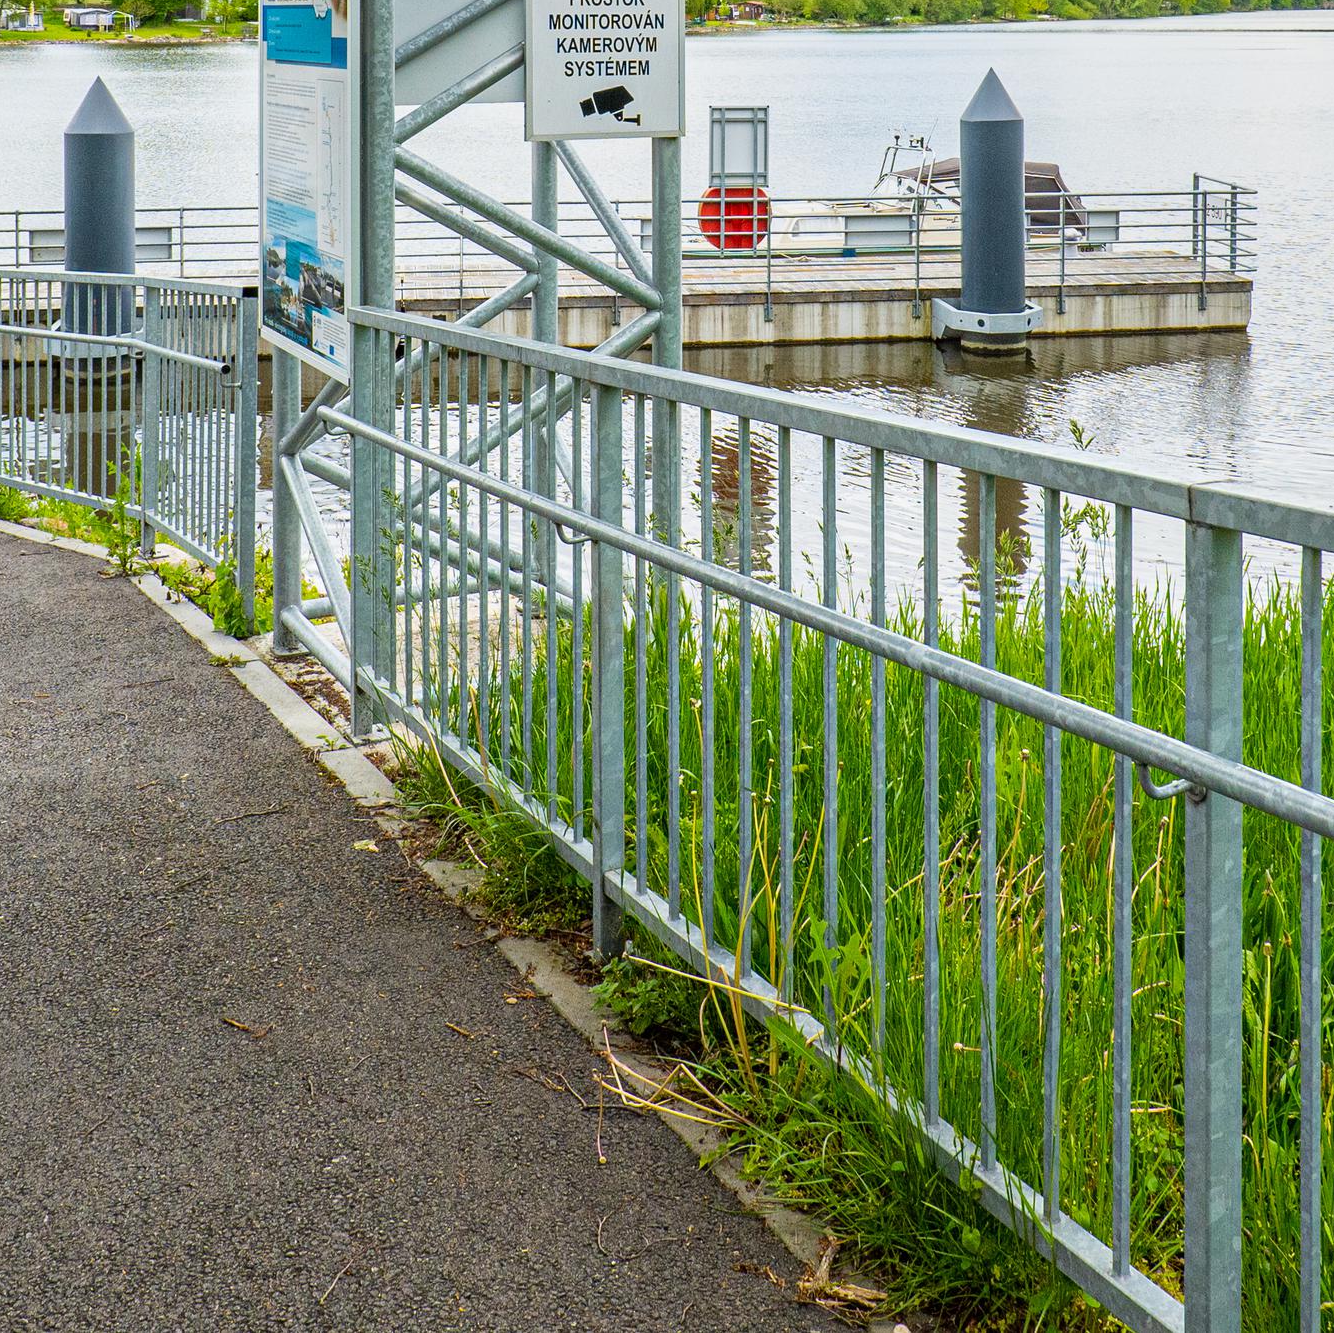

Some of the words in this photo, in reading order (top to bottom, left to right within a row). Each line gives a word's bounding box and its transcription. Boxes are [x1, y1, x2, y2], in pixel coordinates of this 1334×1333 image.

[549, 10, 665, 30] MONITOROVÁN
[556, 33, 658, 53] KAMEROVÝM
[564, 56, 650, 77] SYSTÉMEM
